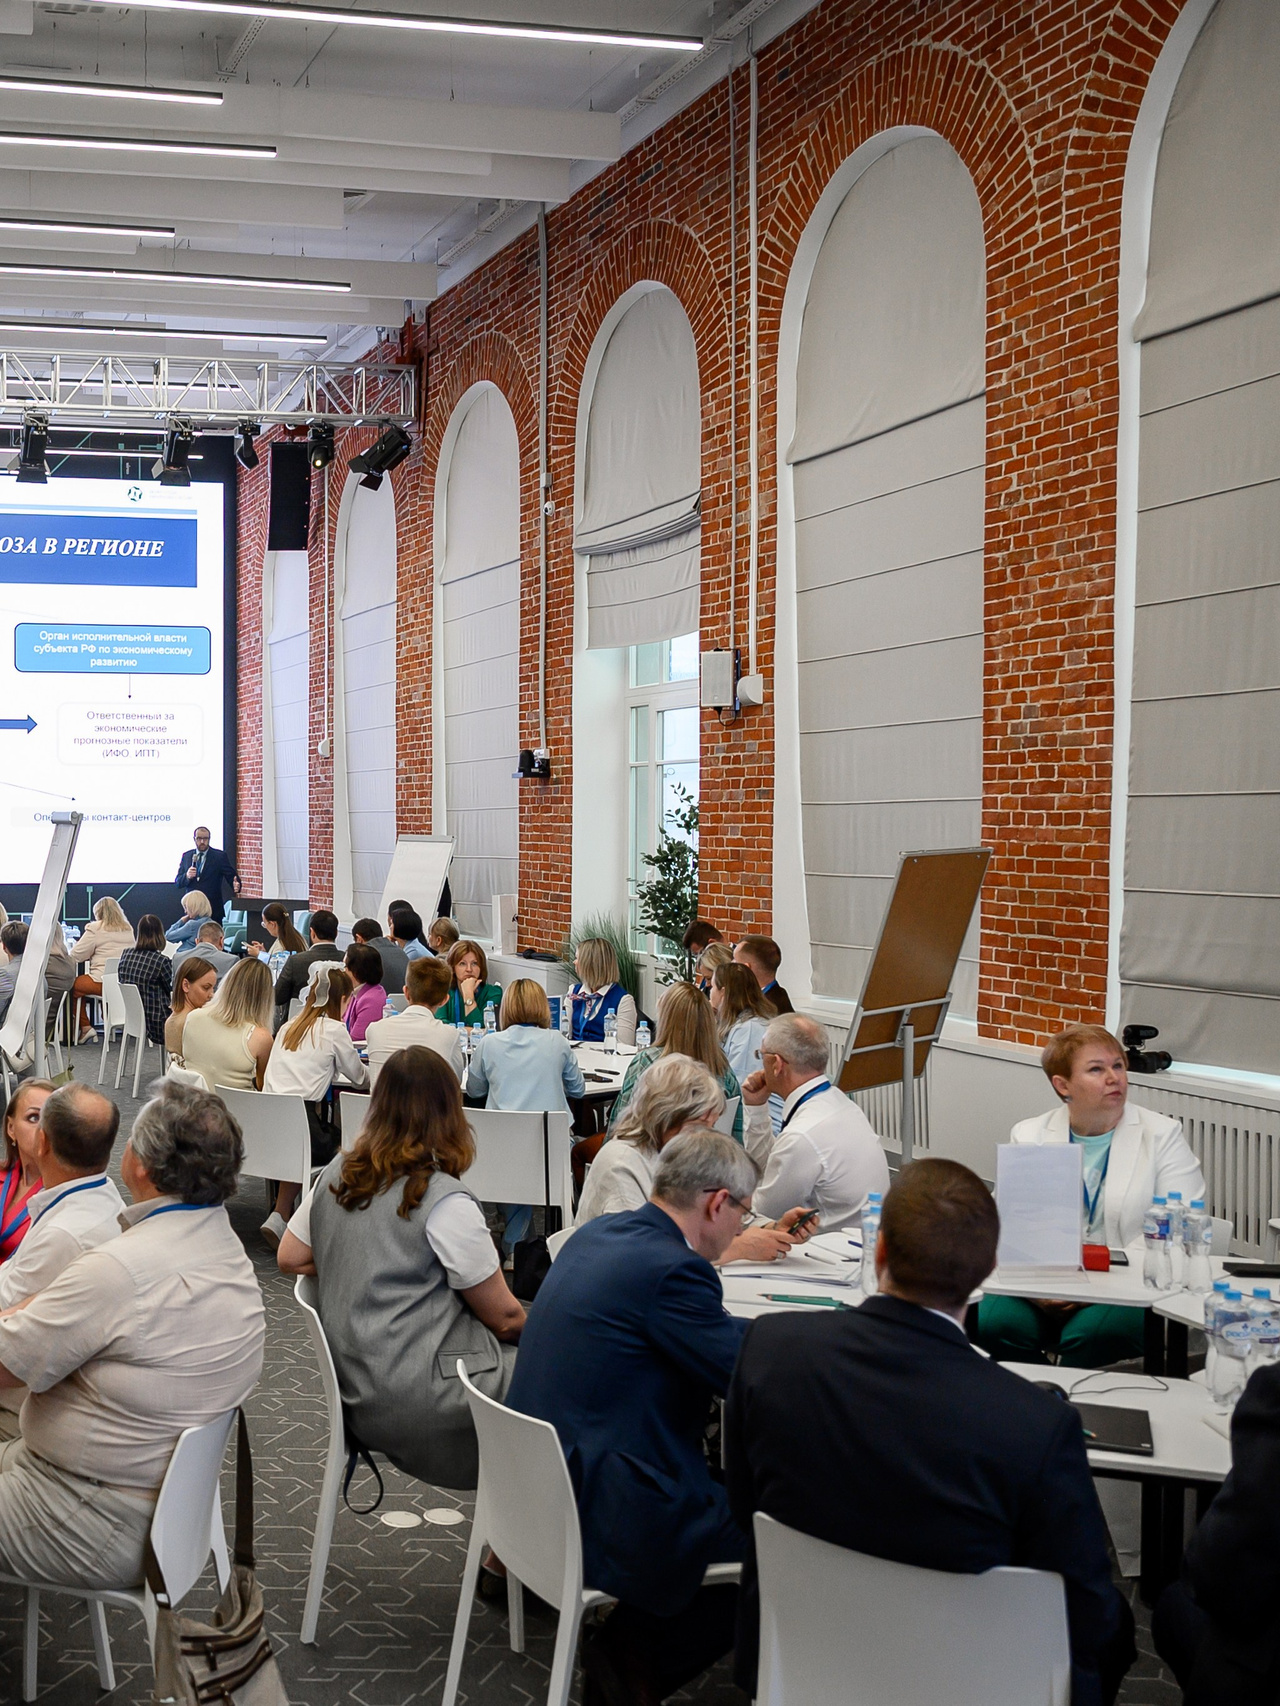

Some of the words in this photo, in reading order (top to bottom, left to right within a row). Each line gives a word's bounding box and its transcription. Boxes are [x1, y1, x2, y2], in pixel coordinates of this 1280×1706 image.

[42, 539, 57, 555] В
[62, 538, 164, 558] РЕГИОНЕ
[40, 631, 69, 642] Орган
[72, 631, 151, 643] исполнительной
[154, 634, 187, 643] власти
[34, 644, 78, 655] субъекта
[81, 644, 96, 654] РФ
[99, 646, 110, 654] по
[113, 646, 192, 657] экономическому
[90, 658, 137, 668] развитию
[87, 710, 161, 721] Ответственный
[164, 712, 174, 720] за
[95, 725, 167, 733] экономические
[74, 736, 130, 747] прогнозные
[134, 737, 187, 746] показатели
[92, 814, 171, 823] контакт-центров
